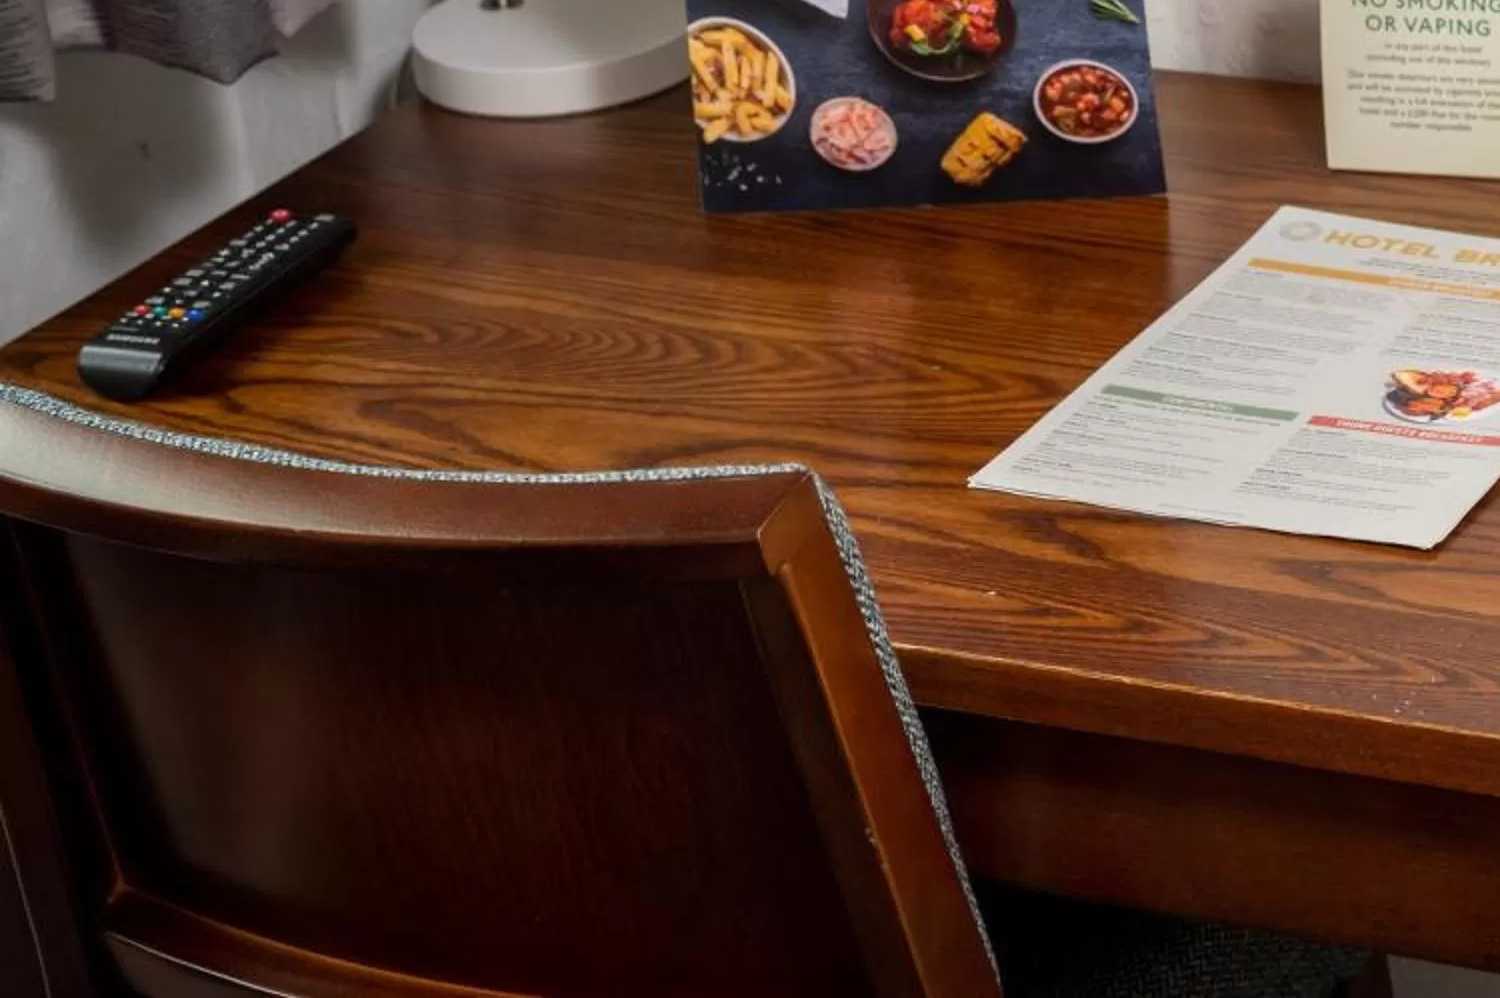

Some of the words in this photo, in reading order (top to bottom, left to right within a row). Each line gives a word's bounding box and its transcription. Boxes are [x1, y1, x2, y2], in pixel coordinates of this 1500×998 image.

[1364, 14, 1397, 33] OR
[1403, 16, 1492, 37] VAPING
[1323, 228, 1441, 260] HOTEL
